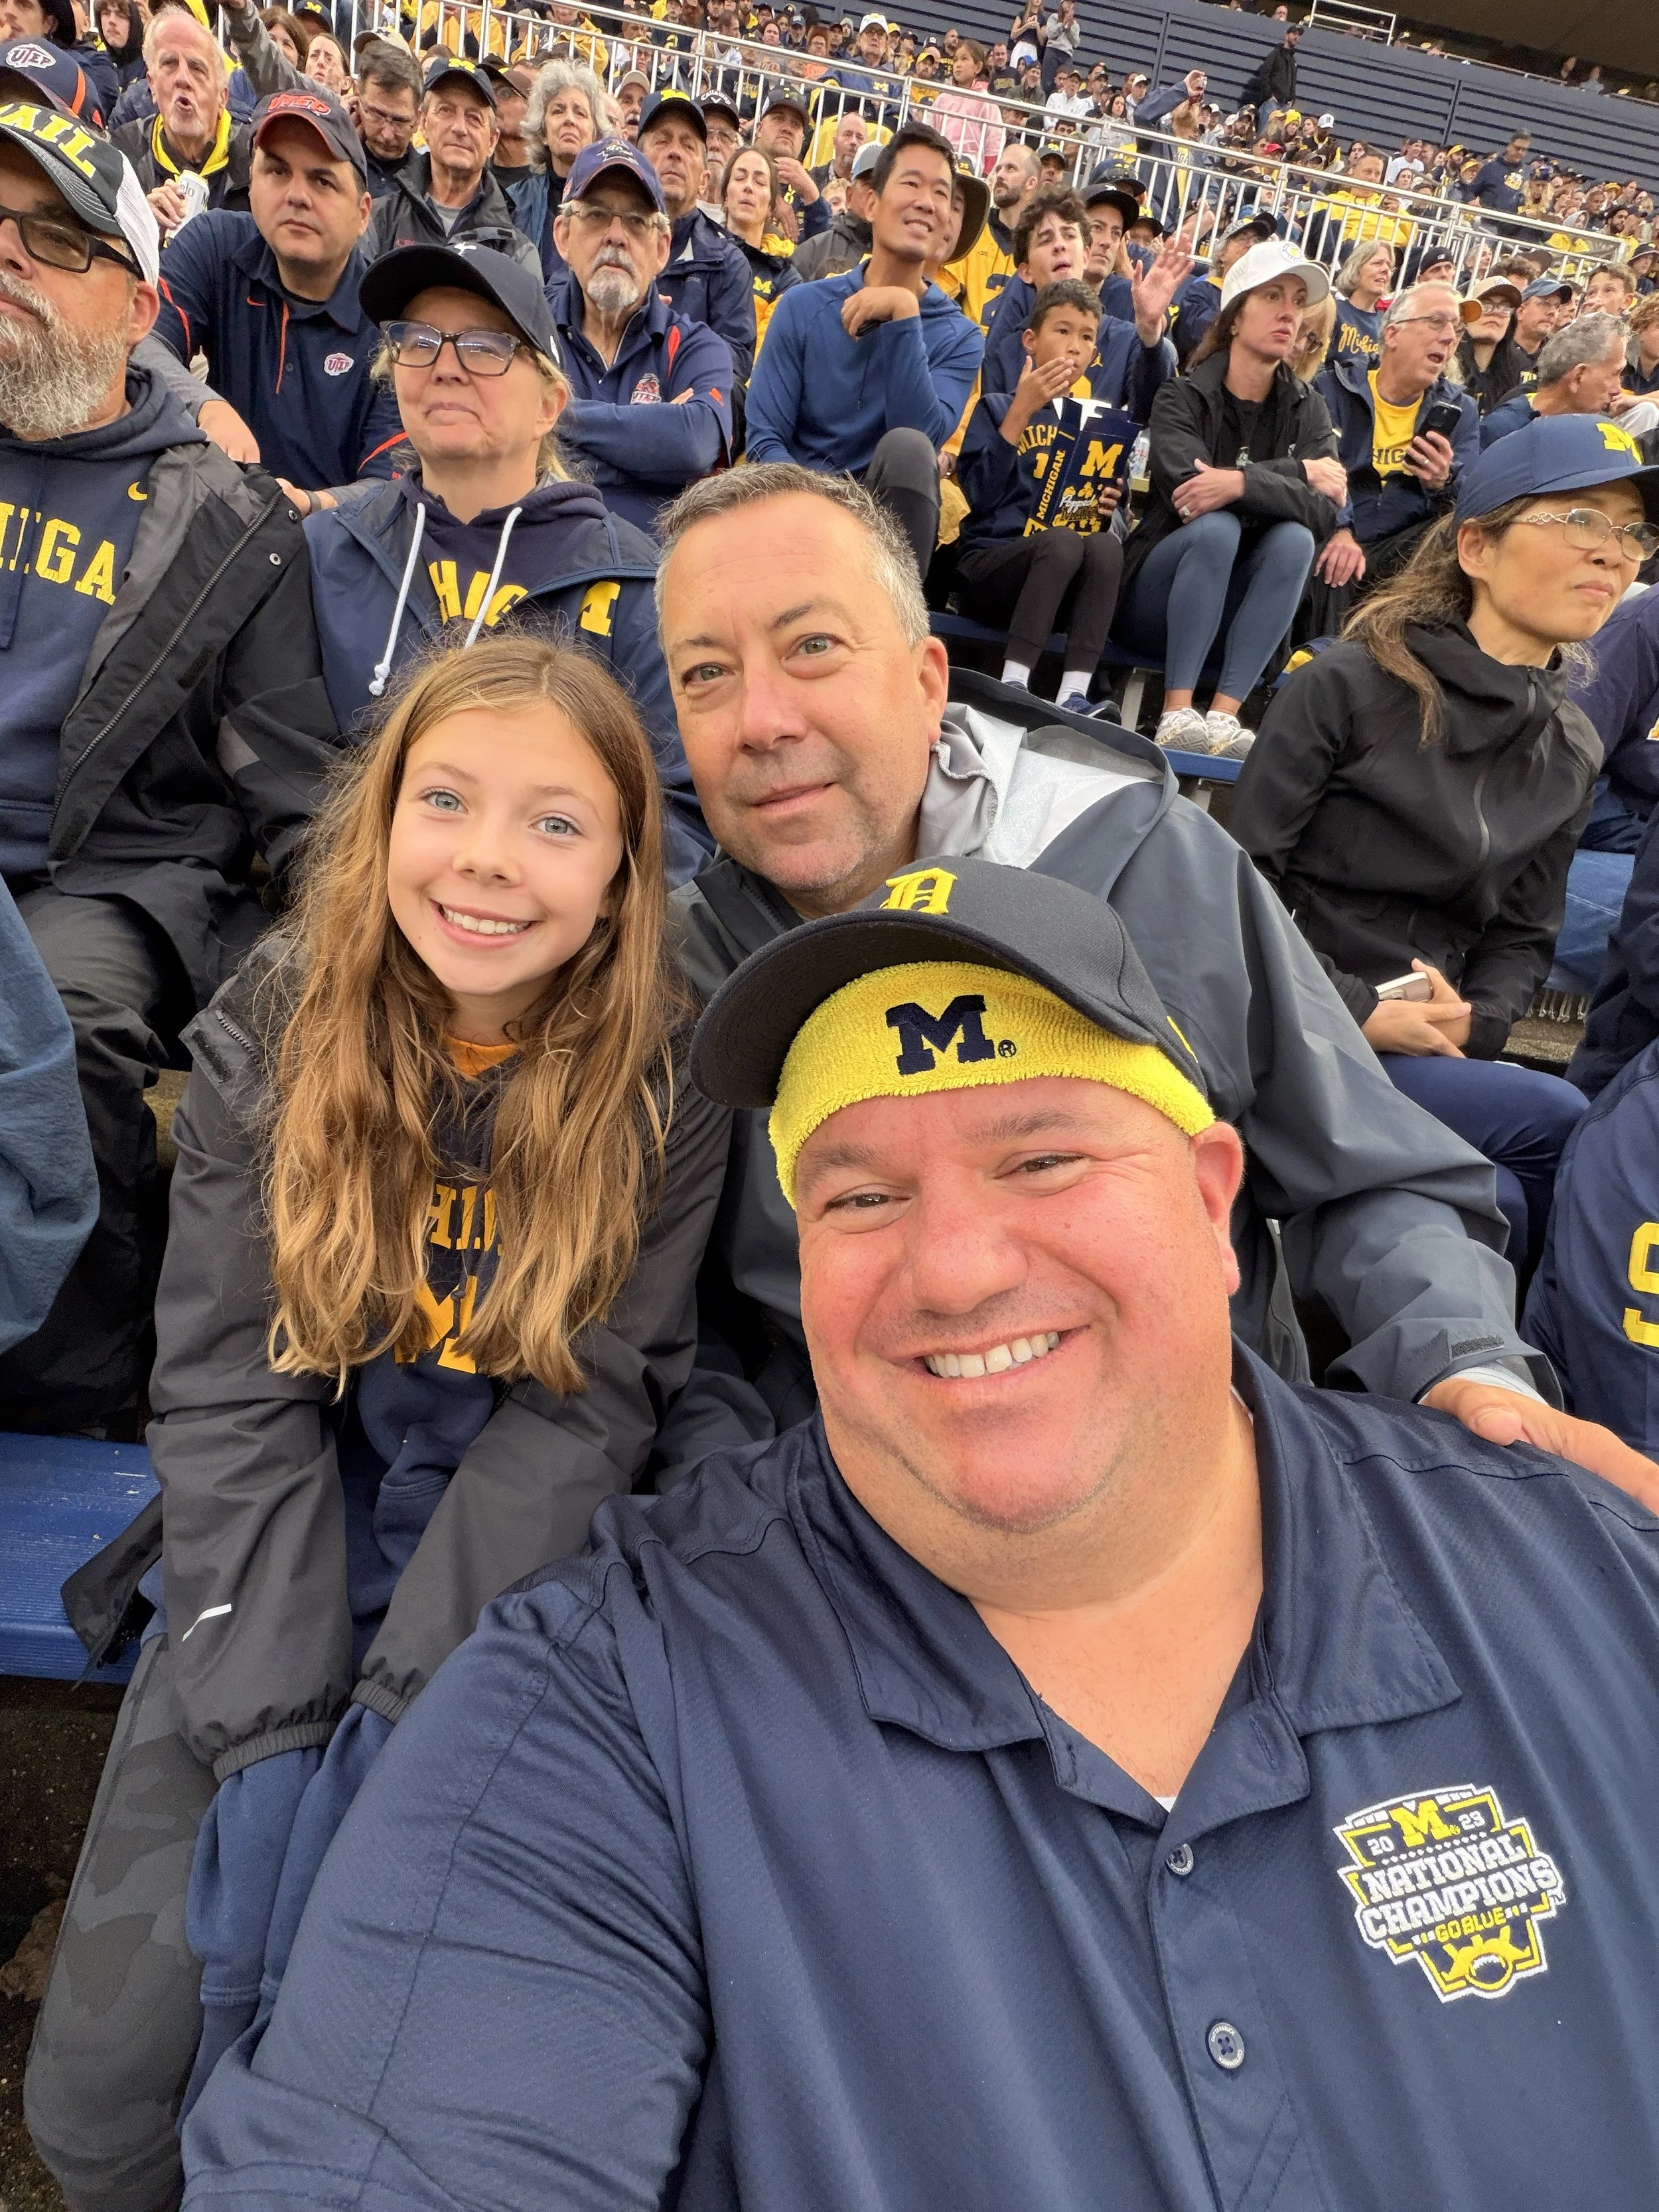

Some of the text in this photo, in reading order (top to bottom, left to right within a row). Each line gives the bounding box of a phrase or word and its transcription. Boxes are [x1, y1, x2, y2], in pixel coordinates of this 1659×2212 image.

[9, 46, 54, 65] UTEP
[267, 94, 331, 116] UTEP
[0, 103, 96, 179] AIL
[753, 276, 772, 294] M
[327, 356, 350, 373] UTEP
[1079, 440, 1123, 479] M
[1036, 449, 1066, 520] MICHIGAN
[1058, 494, 1096, 513] Popped
[885, 994, 995, 1077] M
[1366, 1810, 1486, 1856] 20 23
[1388, 1799, 1451, 1848] M
[1361, 1834, 1526, 1903] NATIONAL
[1364, 1858, 1558, 1940] CHAMPIONS
[1435, 1907, 1506, 1943] GO BLUE
